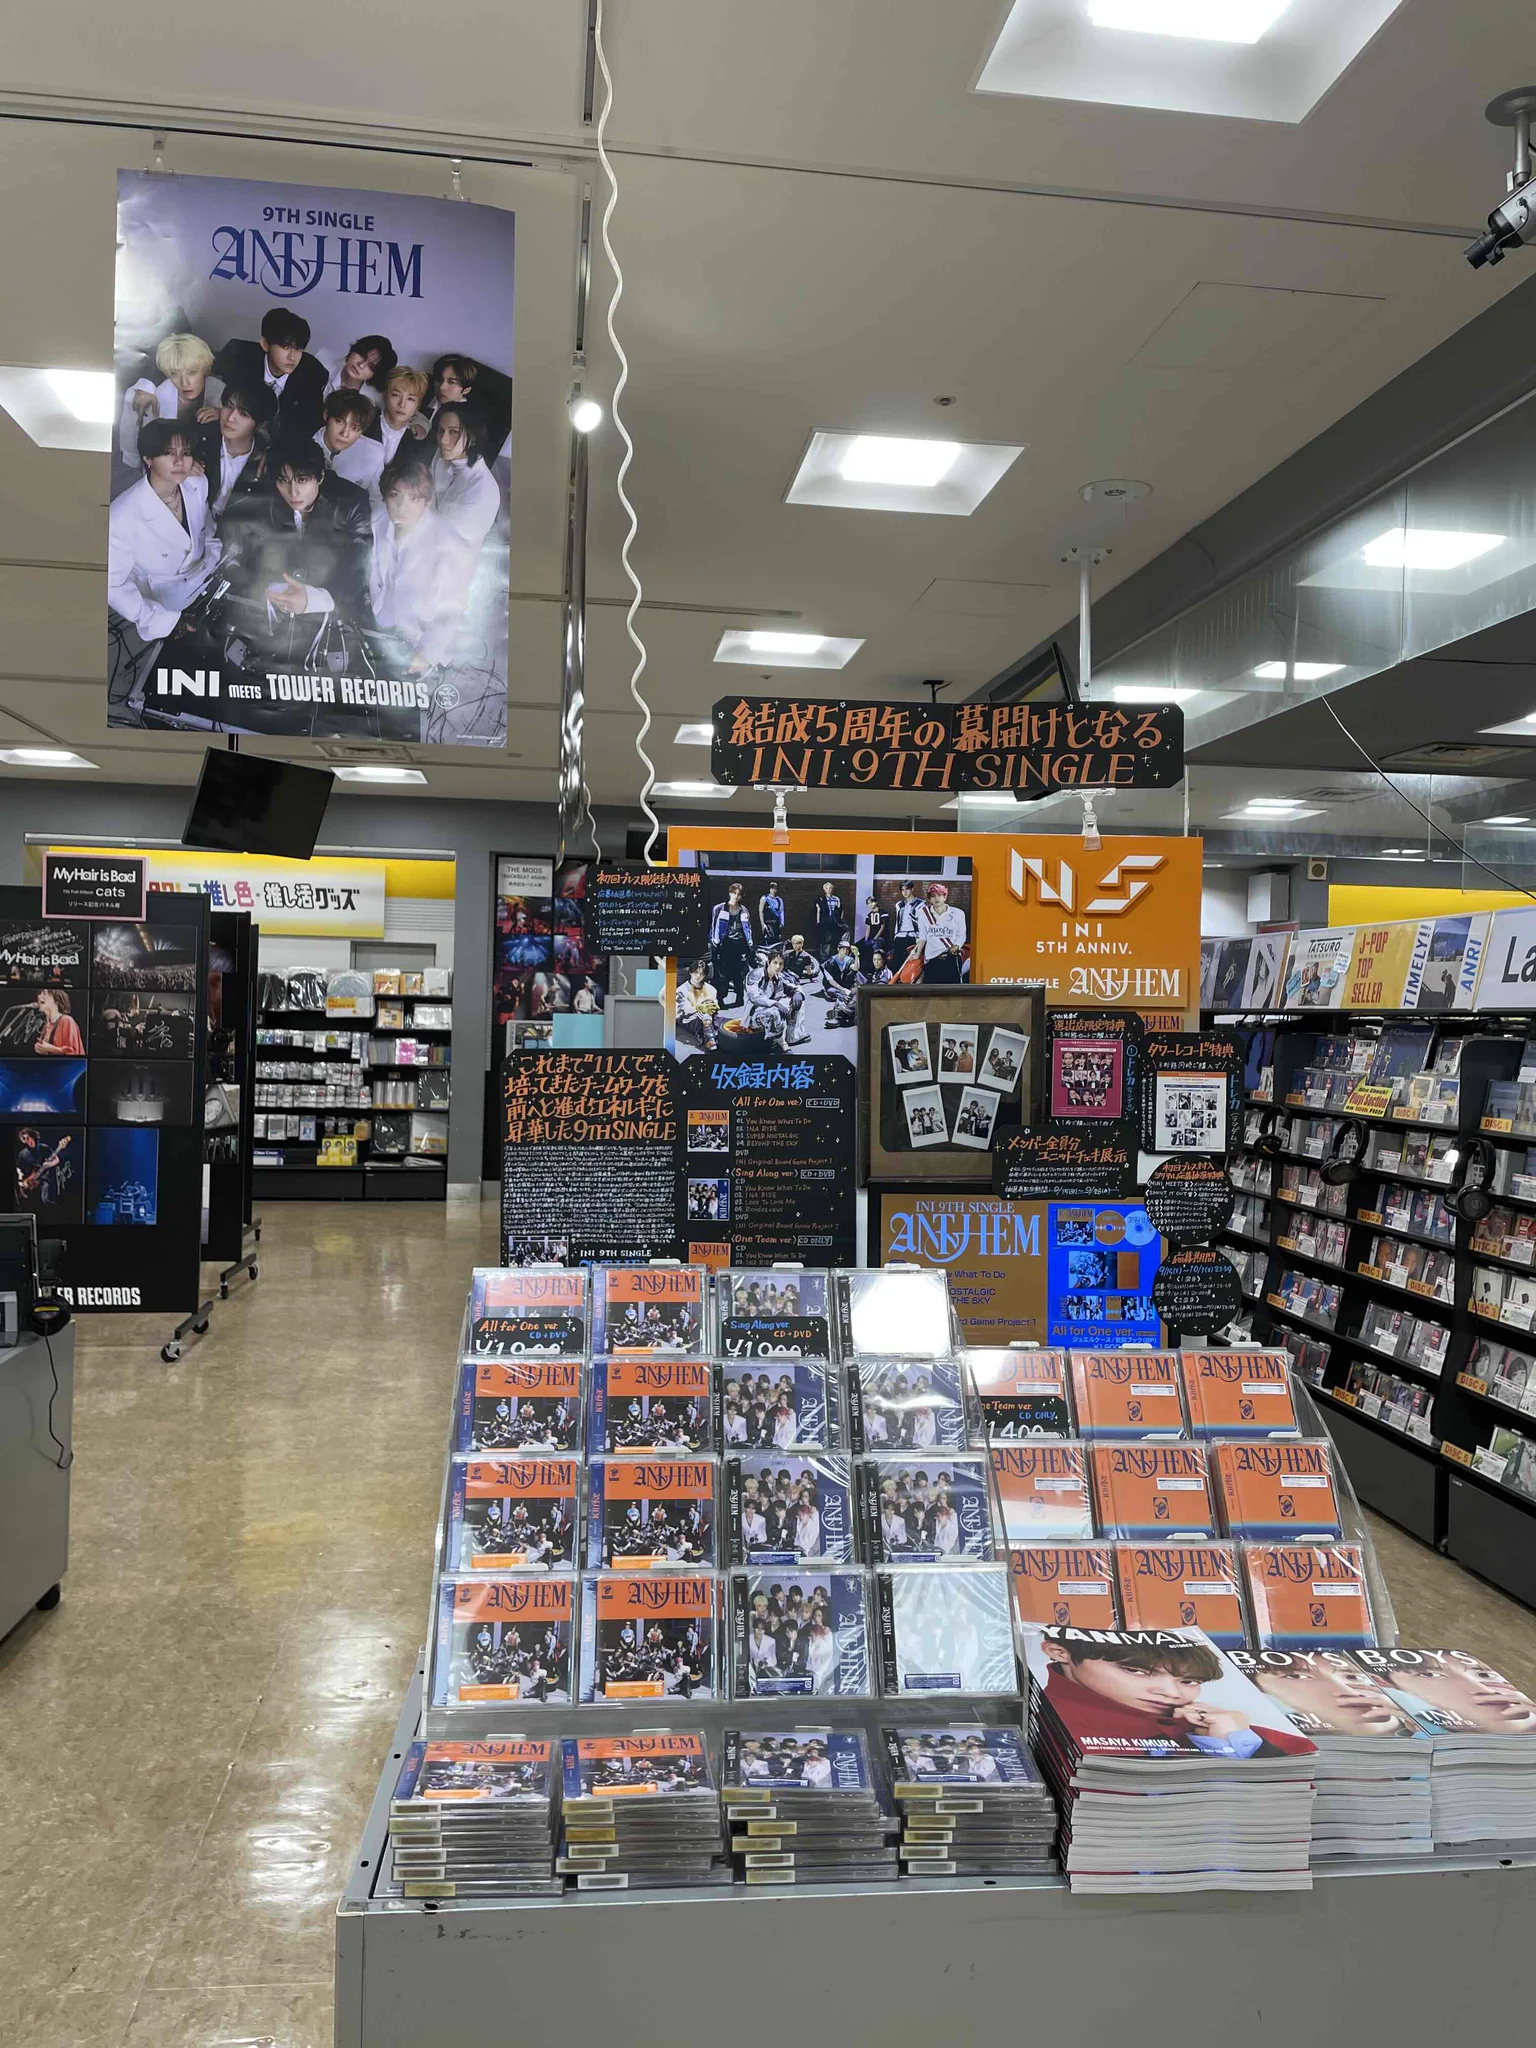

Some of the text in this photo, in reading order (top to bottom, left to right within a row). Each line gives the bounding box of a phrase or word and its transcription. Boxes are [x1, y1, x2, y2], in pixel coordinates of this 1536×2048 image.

[262, 206, 375, 231] 9TH SINGLE
[209, 225, 425, 298] ANTHEM
[156, 668, 220, 697] INI
[228, 684, 262, 700] MEETS
[266, 673, 335, 703] TOWER
[341, 677, 430, 708] RECORDS
[747, 746, 1135, 789] INI 9TH SINGLE
[95, 887, 126, 898] cats
[870, 912, 880, 925] 10
[1062, 922, 1103, 938] INI
[1036, 942, 1132, 955] 5TH ANNIV.
[1308, 937, 1343, 953] TATSURO
[1359, 932, 1389, 954] J-POP
[1357, 959, 1373, 979] TOP
[1403, 924, 1432, 1006] TIMELY!!
[1461, 939, 1483, 992] ANRI
[1069, 966, 1181, 1001] ANTHEM
[1351, 982, 1383, 1004] SELLER
[710, 1061, 816, 1091] 収録内容
[1484, 1118, 1503, 1129] DISC
[915, 1201, 1015, 1213] INI 9TH SINGLE
[1360, 1211, 1374, 1221] DISC
[888, 1212, 1041, 1263] ANTHEM
[599, 1249, 617, 1257] 9TH
[953, 1270, 1006, 1279] What To Do
[632, 1274, 696, 1295] ANTHEM
[948, 1288, 996, 1296] OSTALGIC
[77, 1286, 141, 1306] RECORDS
[951, 1297, 991, 1305] THE SKY
[478, 1320, 499, 1332] All
[500, 1321, 517, 1332] for
[520, 1321, 539, 1330] One
[730, 1320, 750, 1331] Sing
[751, 1320, 774, 1330] Along
[967, 1318, 995, 1326] Game
[997, 1317, 1032, 1328] Project
[1052, 1325, 1067, 1336] All
[1070, 1325, 1085, 1336] for
[1088, 1325, 1112, 1336] One
[1089, 1357, 1171, 1384] ANTHEM
[1200, 1356, 1282, 1382] ANTHEM
[1459, 1376, 1477, 1389] DISC
[992, 1400, 1016, 1410] Team
[1019, 1411, 1056, 1420] CD ONLY
[1444, 1444, 1461, 1460] DISC
[633, 1464, 708, 1490] ANTHEM
[1136, 1549, 1228, 1581] ANTHEM
[1226, 1650, 1349, 1668] BOYS
[1355, 1650, 1479, 1666] BOYS
[1289, 1713, 1321, 1724] NI
[1420, 1710, 1464, 1723] INI
[1080, 1736, 1181, 1748] MASAYA KIMURA
